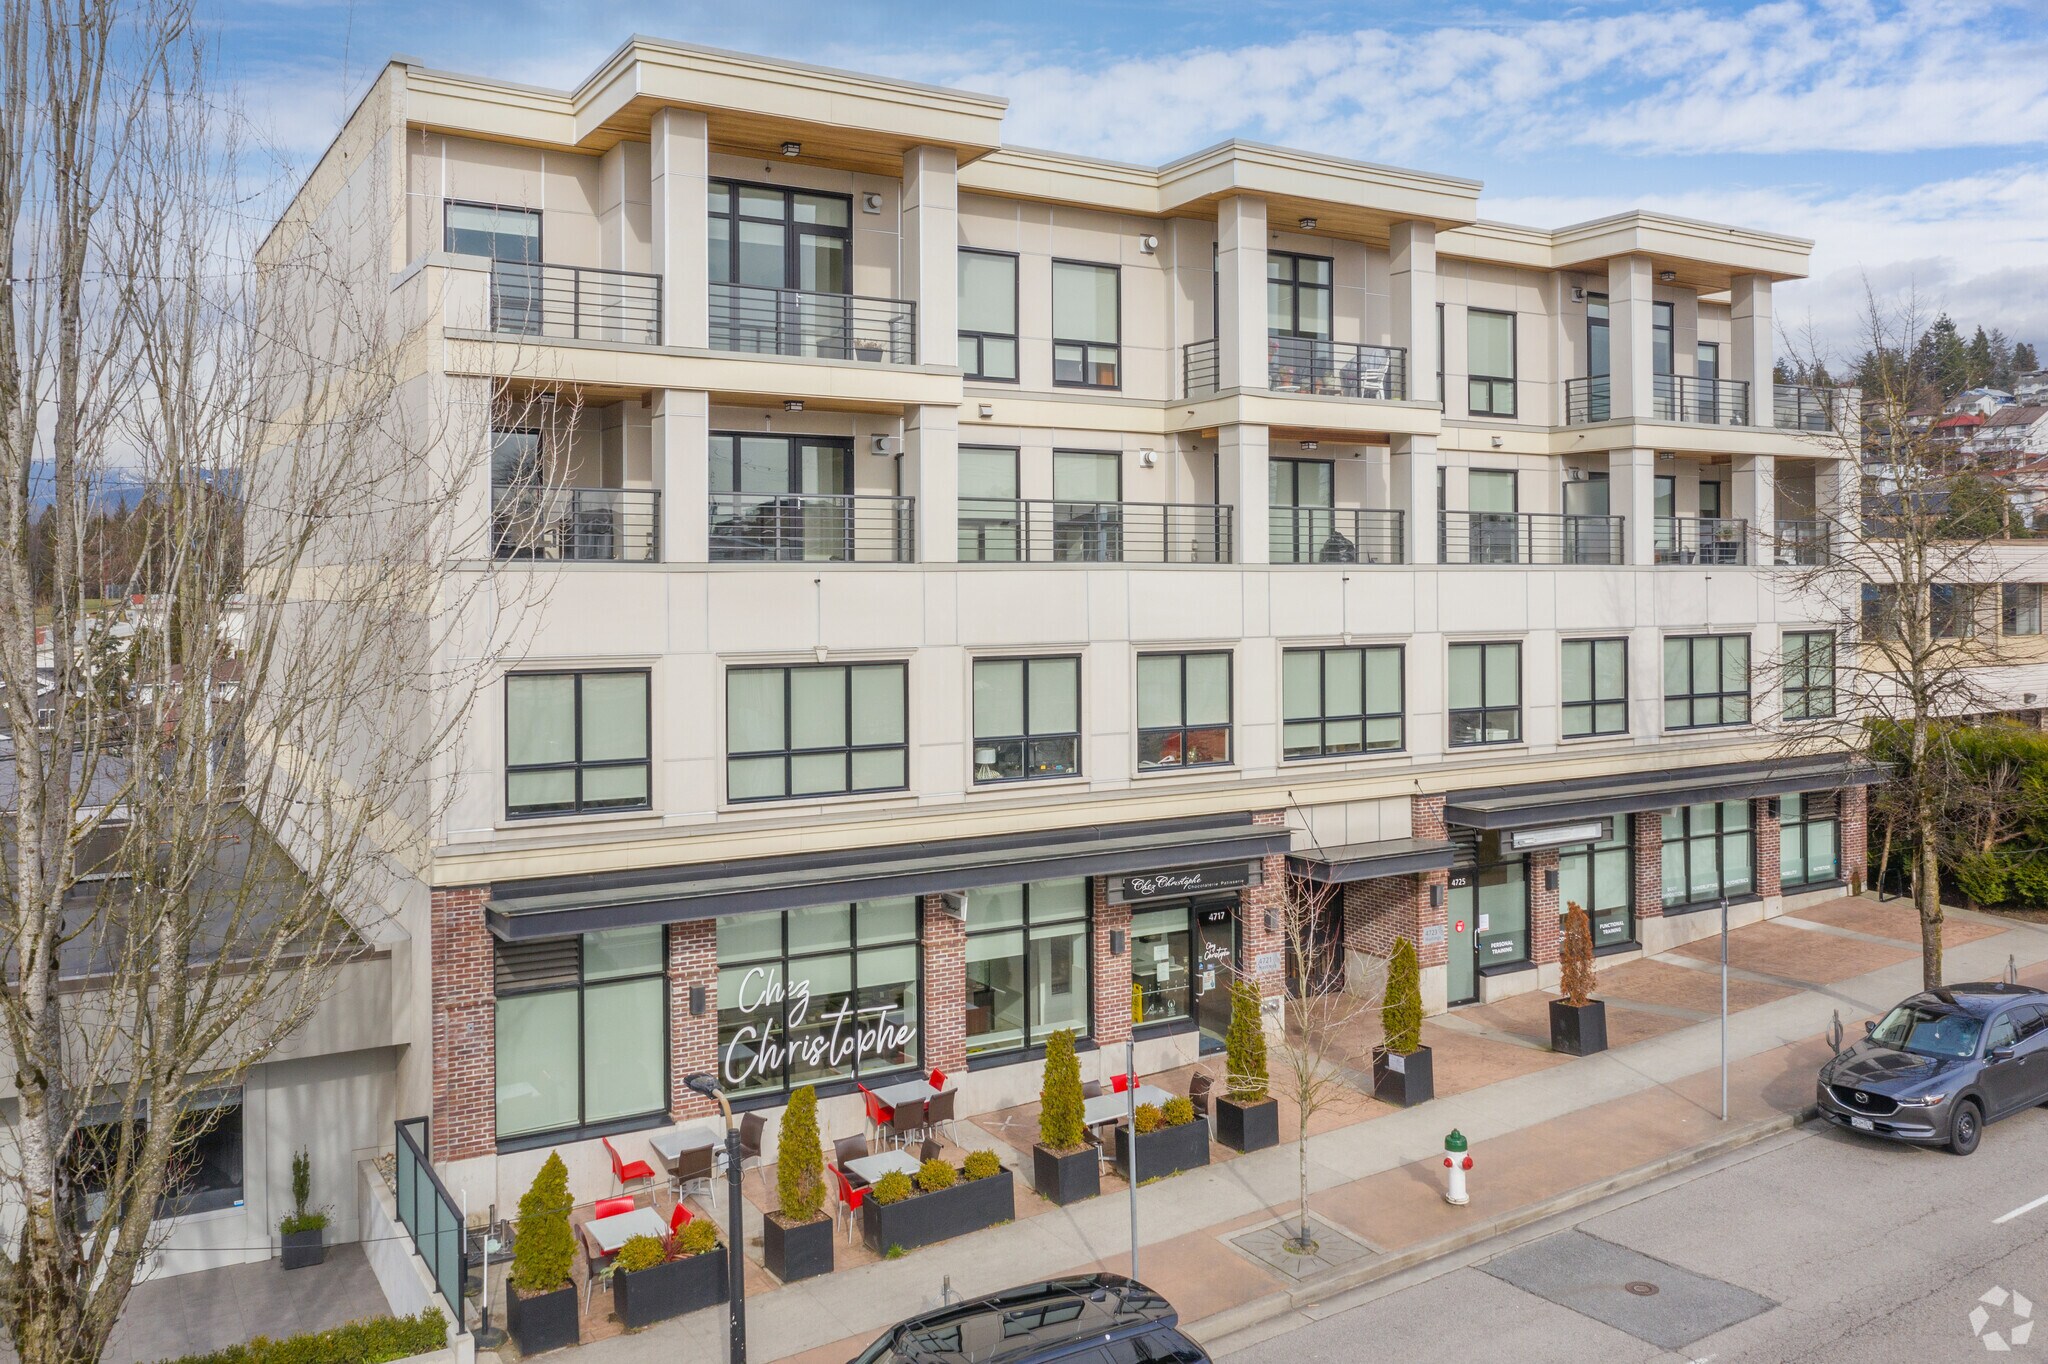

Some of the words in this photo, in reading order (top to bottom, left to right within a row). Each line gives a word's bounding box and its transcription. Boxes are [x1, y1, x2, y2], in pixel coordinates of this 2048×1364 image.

[1131, 878, 1156, 895] Chez
[1155, 873, 1202, 890] Christophe
[1451, 877, 1466, 886] 4725
[1208, 911, 1225, 921] 4717
[1600, 921, 1625, 929] FUNCTIONAL
[1603, 927, 1622, 936] TRAINING
[1490, 940, 1514, 949] PERSONAL
[1491, 946, 1513, 955] TRAINING
[1258, 956, 1272, 964] 4721
[738, 967, 810, 1028] Chez
[724, 997, 917, 1083] Christophe
